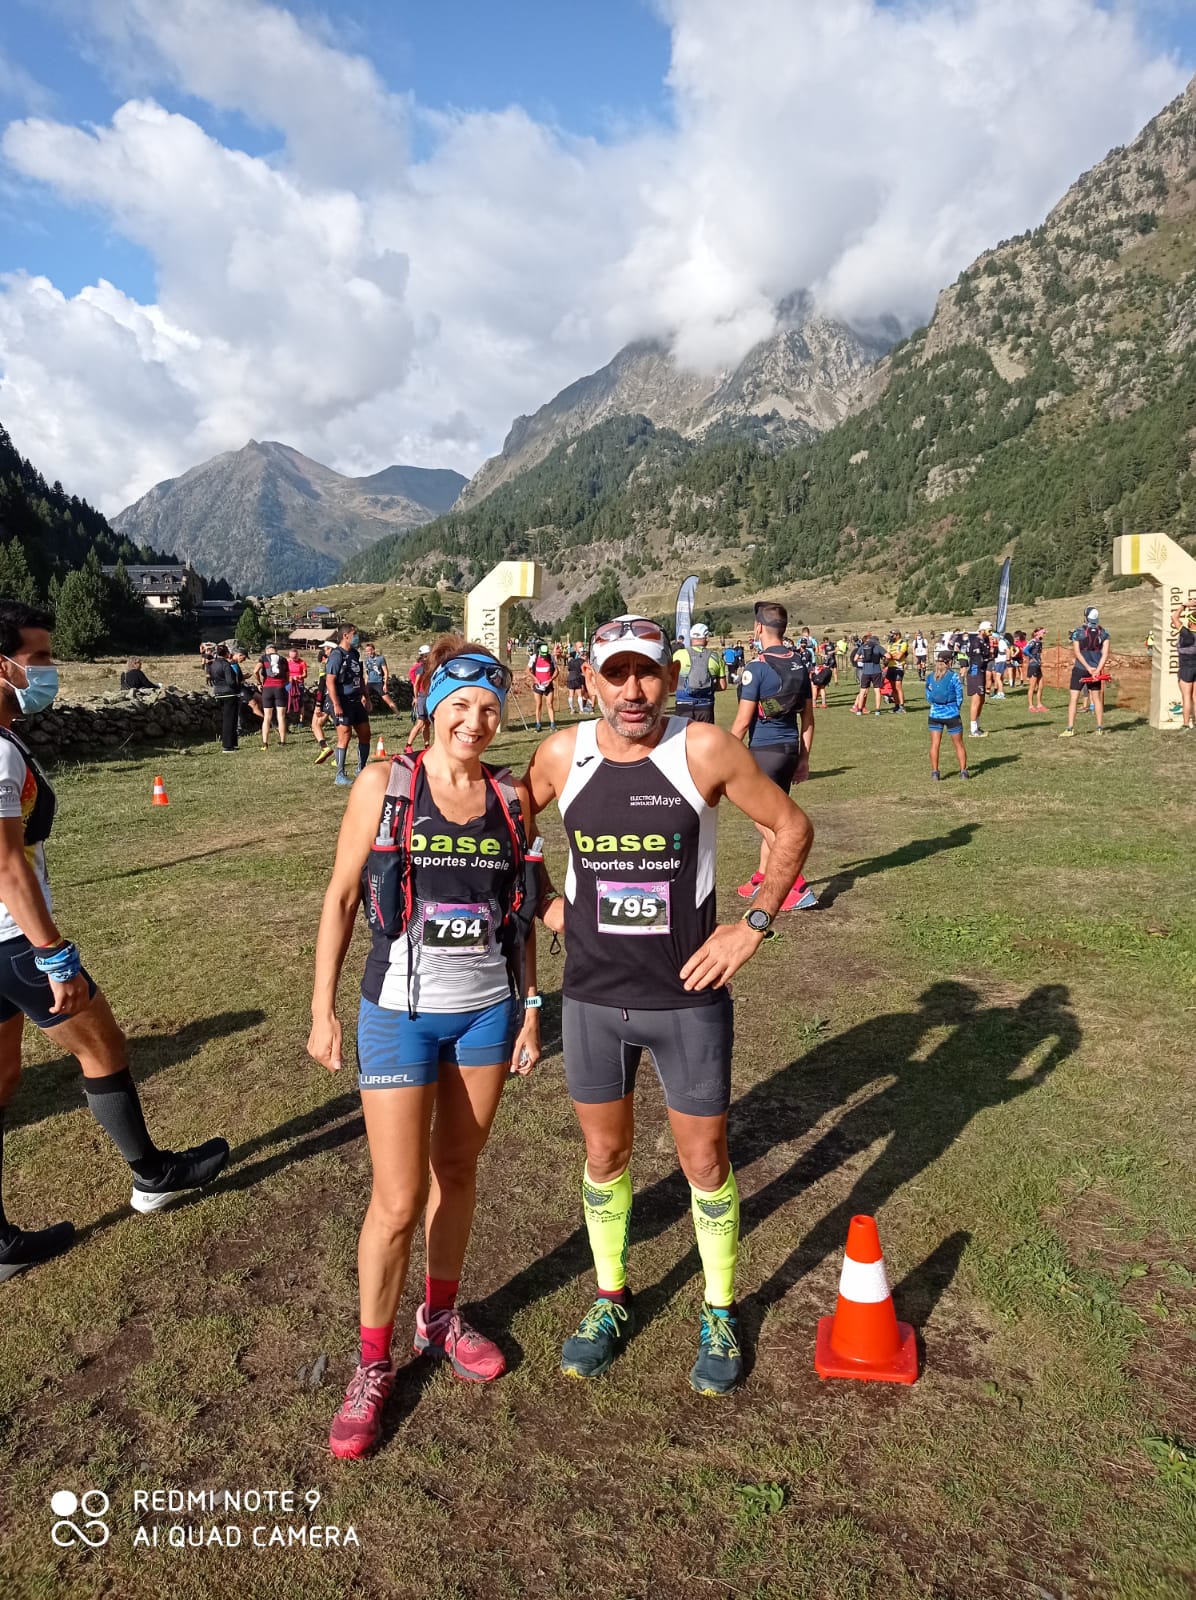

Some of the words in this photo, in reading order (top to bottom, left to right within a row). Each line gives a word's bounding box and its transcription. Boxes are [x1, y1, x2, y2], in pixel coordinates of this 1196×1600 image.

[652, 795, 681, 808] Maye
[410, 855, 467, 868] eportes
[638, 858, 681, 870] Josele
[608, 897, 658, 918] 795
[435, 919, 482, 939] 794
[360, 1074, 414, 1085] LURBEL
